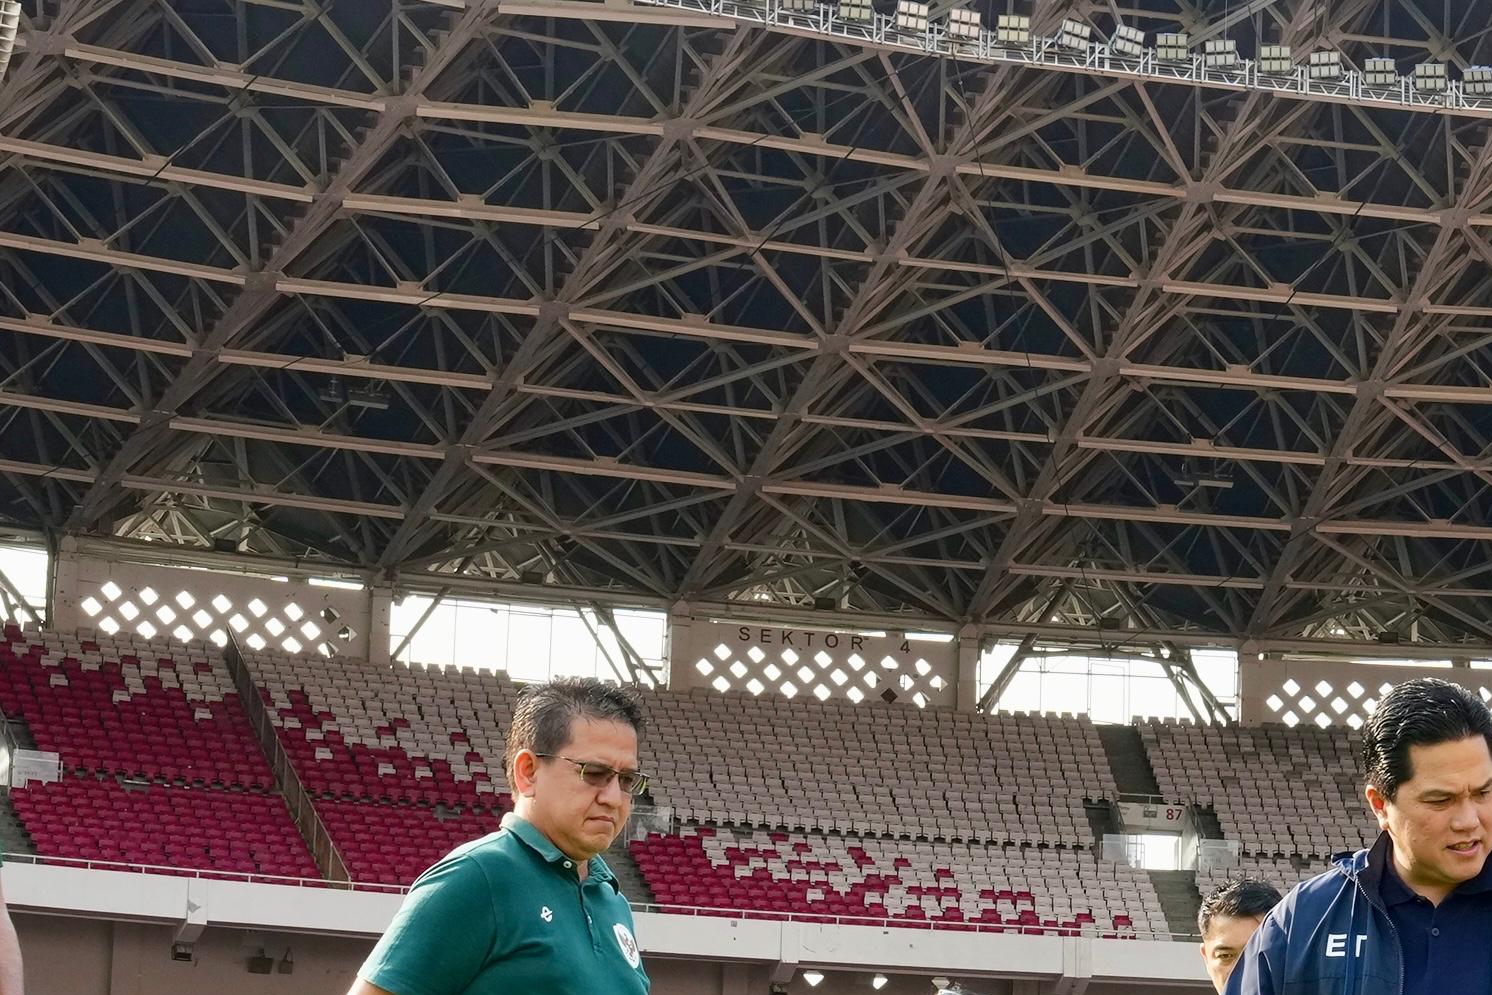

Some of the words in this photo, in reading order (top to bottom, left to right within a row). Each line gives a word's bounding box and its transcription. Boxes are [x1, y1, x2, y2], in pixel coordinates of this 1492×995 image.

[738, 626, 864, 650] SEKTOR
[900, 640, 911, 654] 4
[1166, 808, 1183, 820] 87
